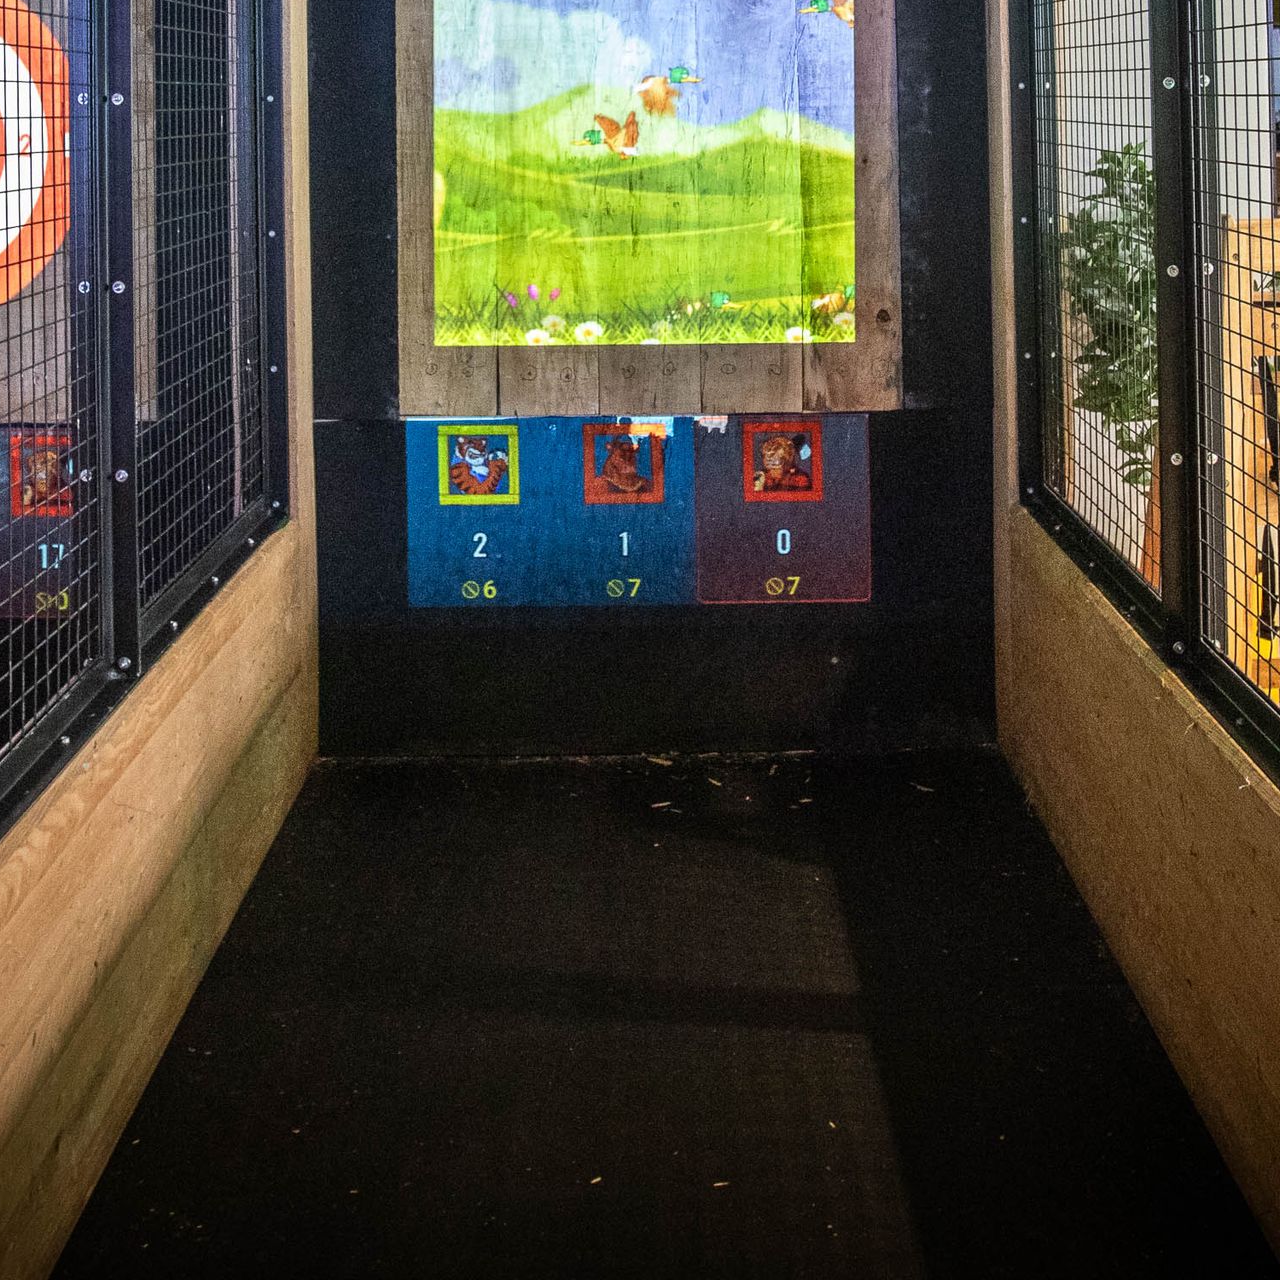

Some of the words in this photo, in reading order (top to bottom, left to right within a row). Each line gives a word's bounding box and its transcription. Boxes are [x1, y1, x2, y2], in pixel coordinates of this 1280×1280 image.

[20, 134, 32, 157] 2
[472, 532, 488, 558] 2
[618, 531, 629, 557] 1
[776, 529, 792, 555] 0
[38, 543, 65, 569] 17
[483, 580, 497, 599] 6
[628, 578, 641, 598] 7
[787, 576, 801, 595] 7
